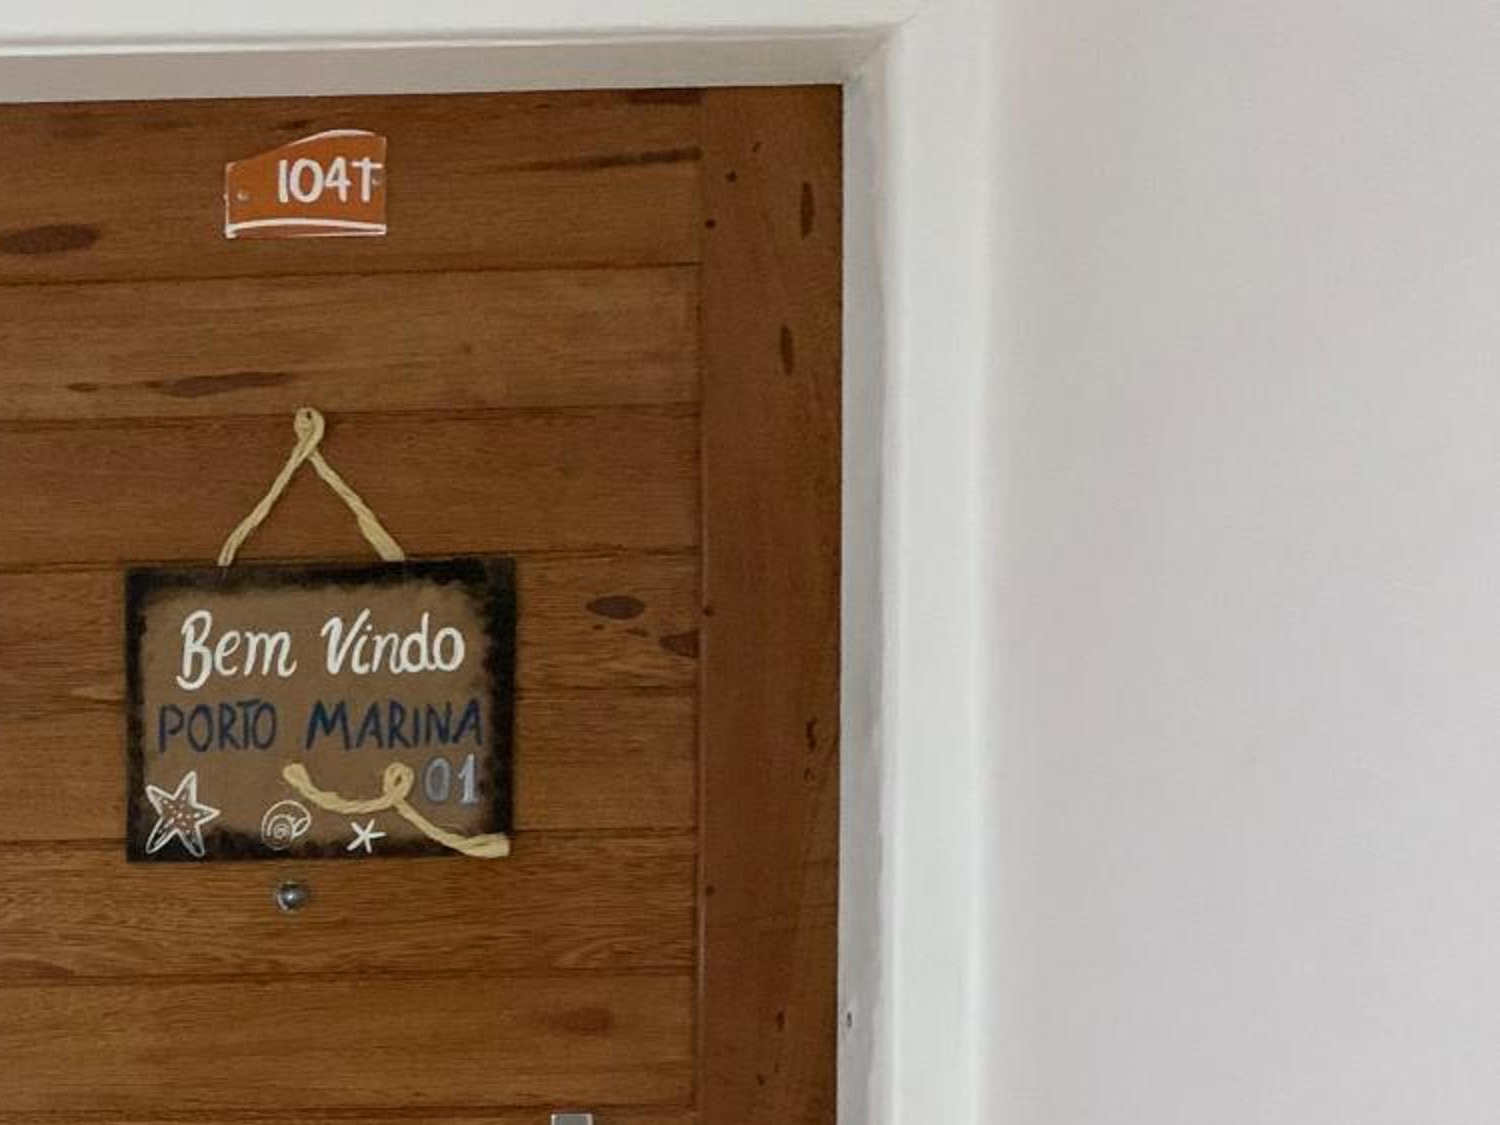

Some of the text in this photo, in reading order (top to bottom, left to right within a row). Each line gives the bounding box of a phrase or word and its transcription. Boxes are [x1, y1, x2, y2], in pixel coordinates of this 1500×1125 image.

[277, 156, 384, 204] 104T
[176, 607, 467, 691] Bem Vindo
[157, 697, 486, 754] PORTO MARINA
[422, 753, 480, 806] 01
